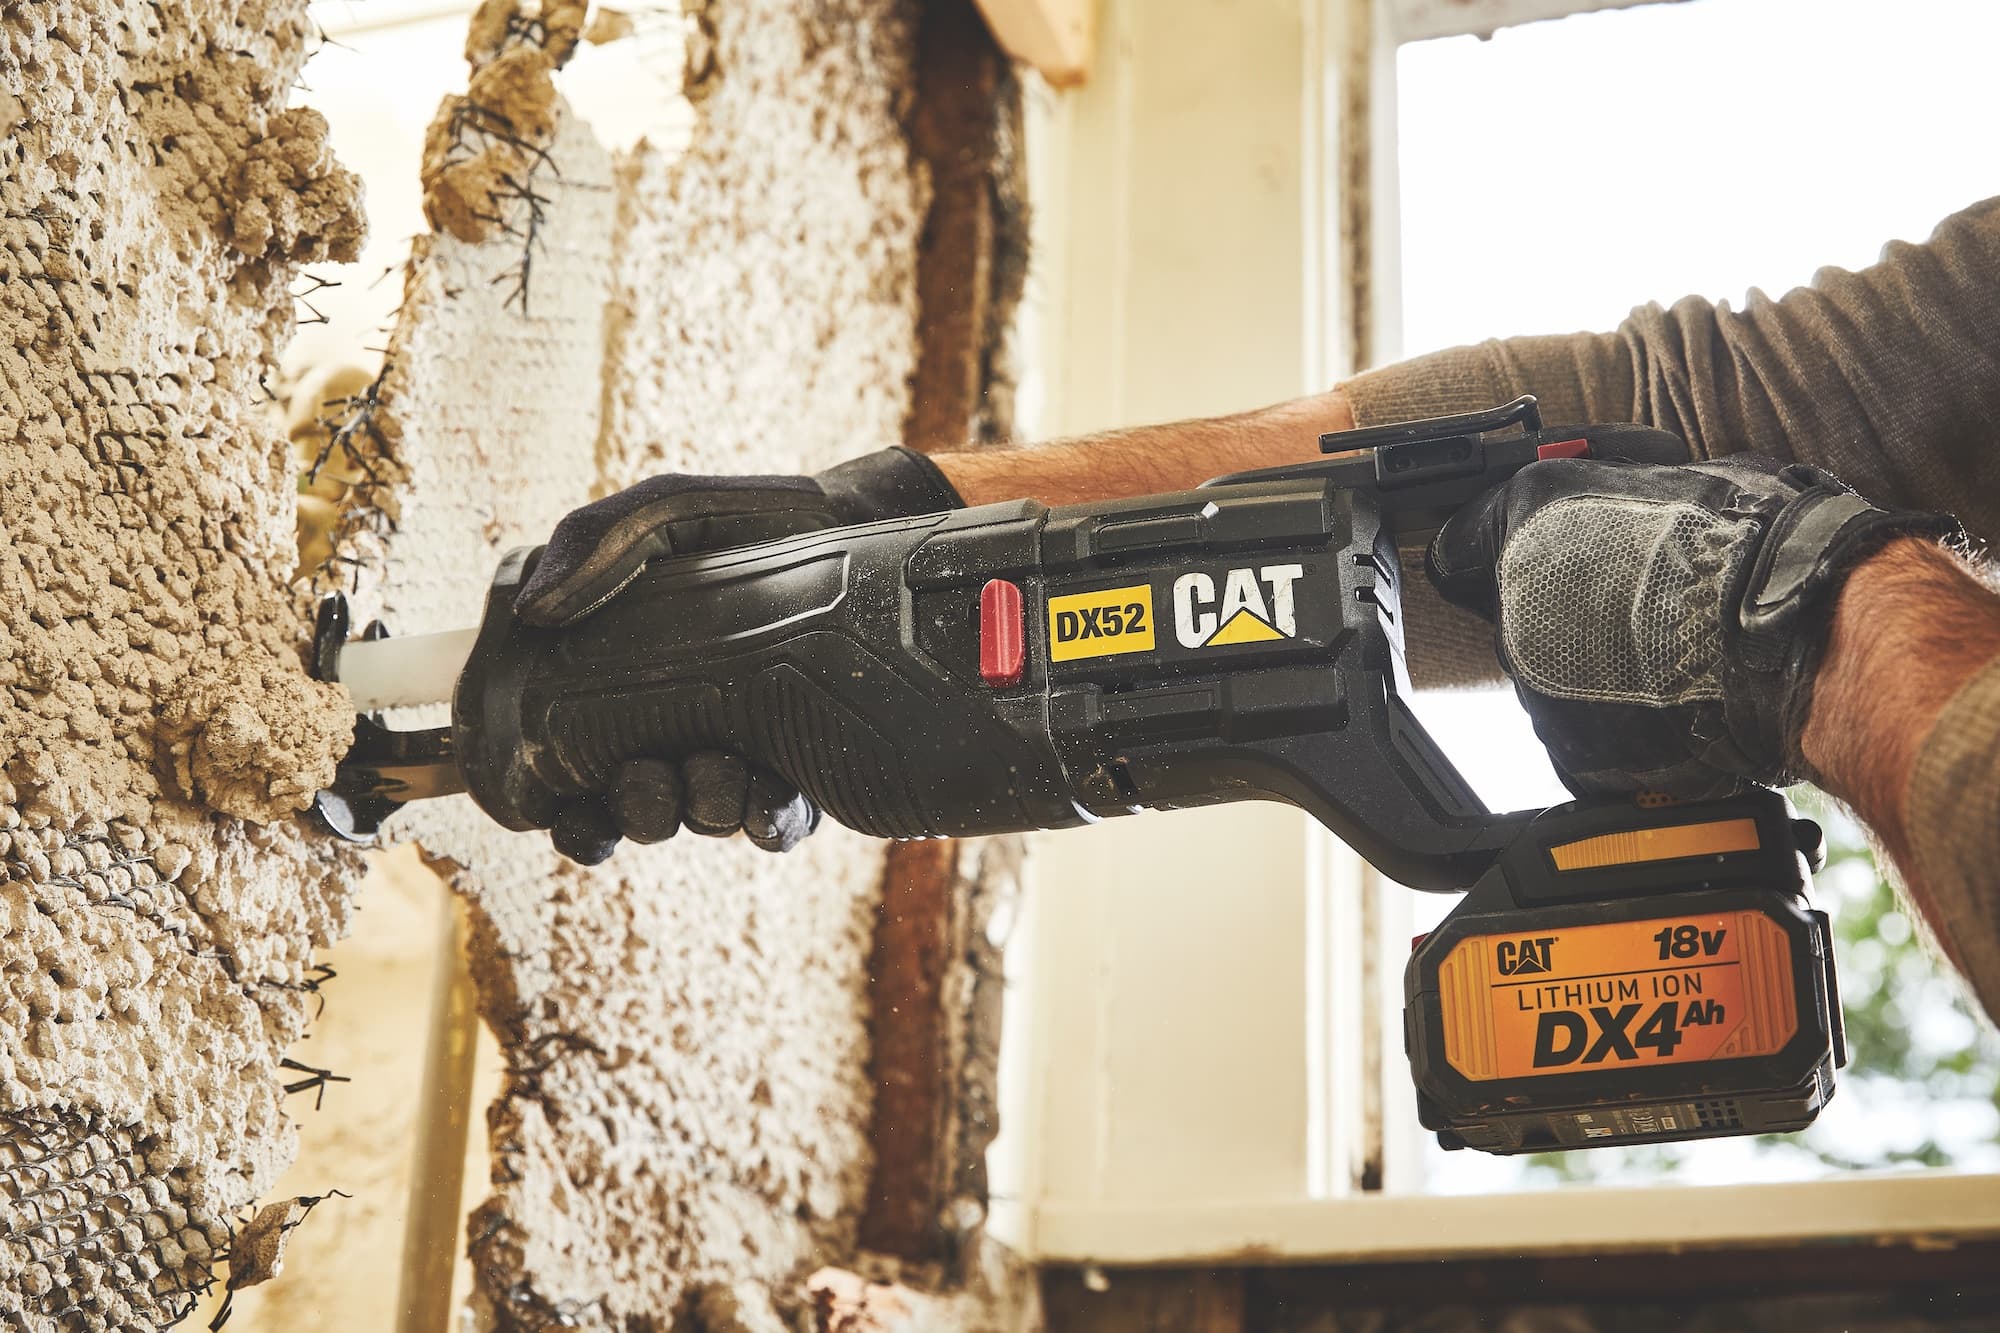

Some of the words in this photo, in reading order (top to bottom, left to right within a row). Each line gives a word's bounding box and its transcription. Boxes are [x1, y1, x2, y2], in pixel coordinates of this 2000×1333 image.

[1056, 603, 1146, 643] DX52
[1173, 564, 1303, 649] CAT
[1497, 937, 1554, 976] CAT
[1518, 979, 1639, 1011] LITHIUM
[1653, 972, 1702, 998] ION
